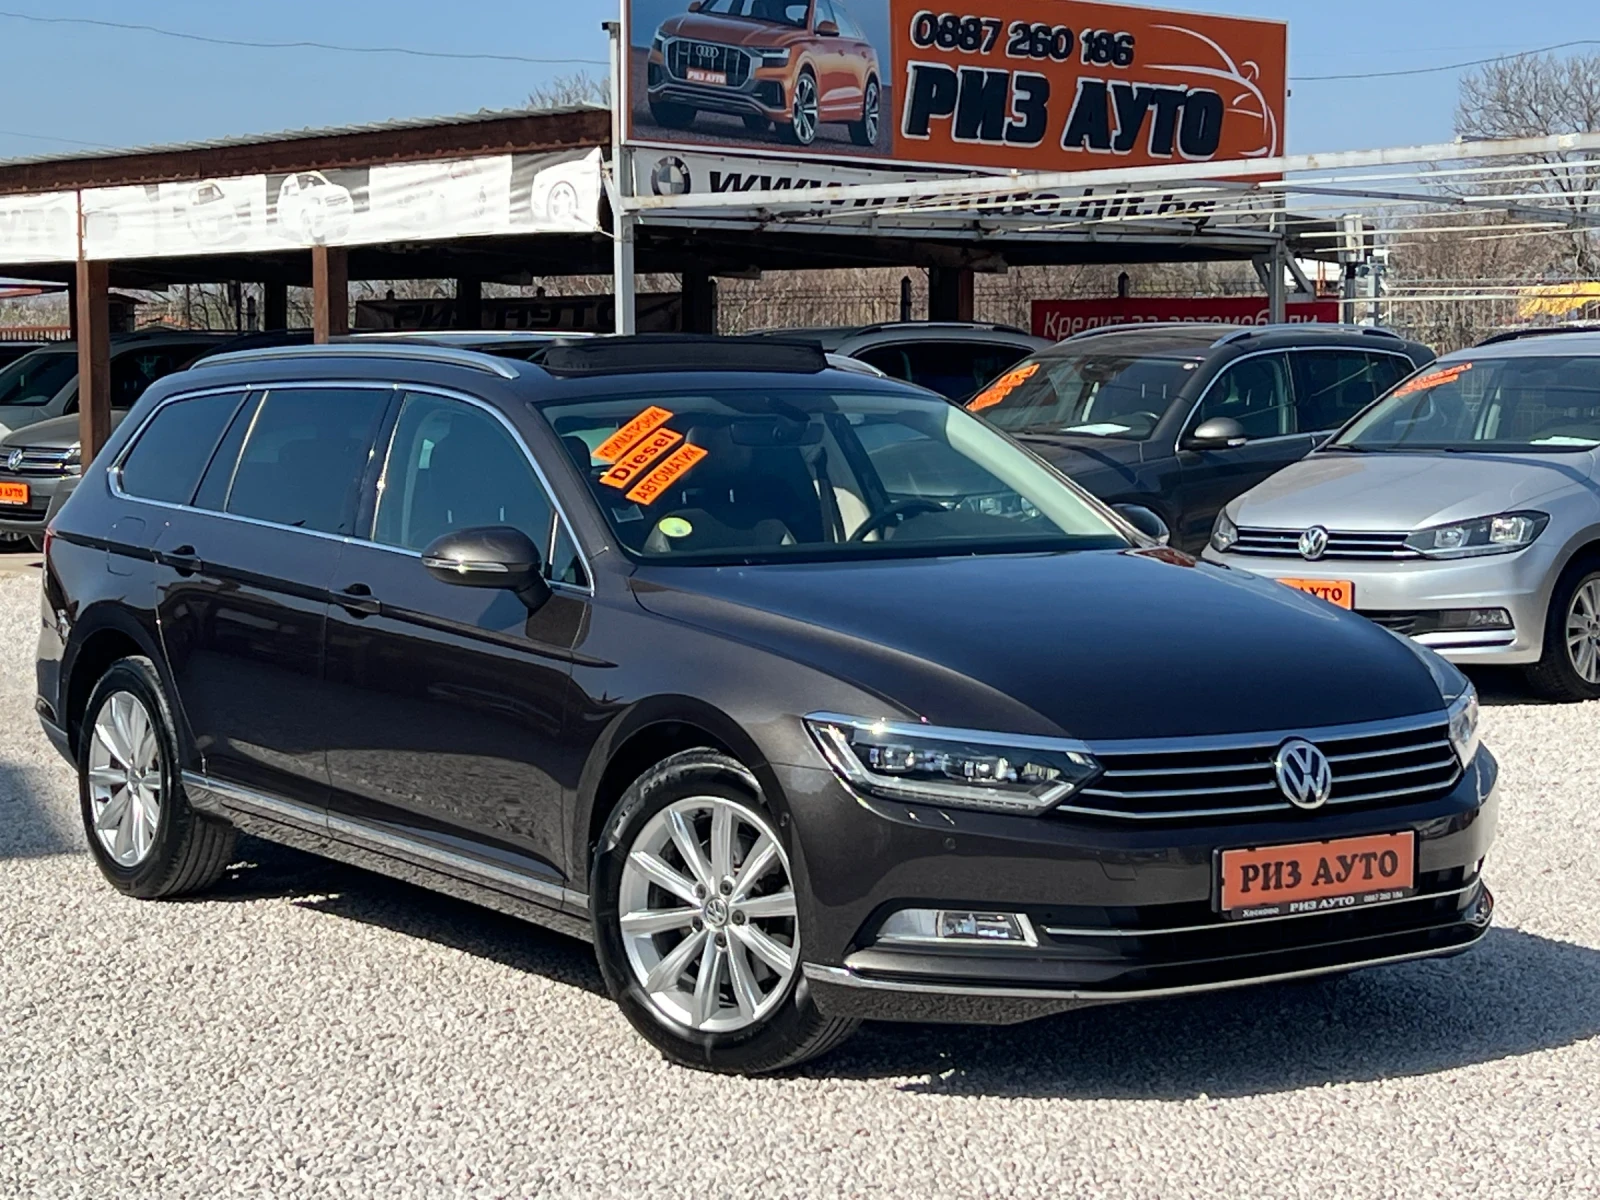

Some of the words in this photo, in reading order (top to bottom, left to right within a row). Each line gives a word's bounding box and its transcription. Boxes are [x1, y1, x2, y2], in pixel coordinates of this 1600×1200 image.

[910, 10, 1003, 55] 0887
[1005, 21, 1074, 62] 260
[1079, 28, 1136, 69] 186
[901, 60, 1051, 148] РИЗ
[1060, 77, 1224, 160] АУТО
[611, 431, 675, 481] Diesel
[635, 446, 698, 500] АВТОМАТИК
[1240, 860, 1302, 893] РИЗ
[1311, 850, 1399, 887] АУТО
[1289, 900, 1317, 913] РИЗ
[1318, 895, 1355, 910] АУТО
